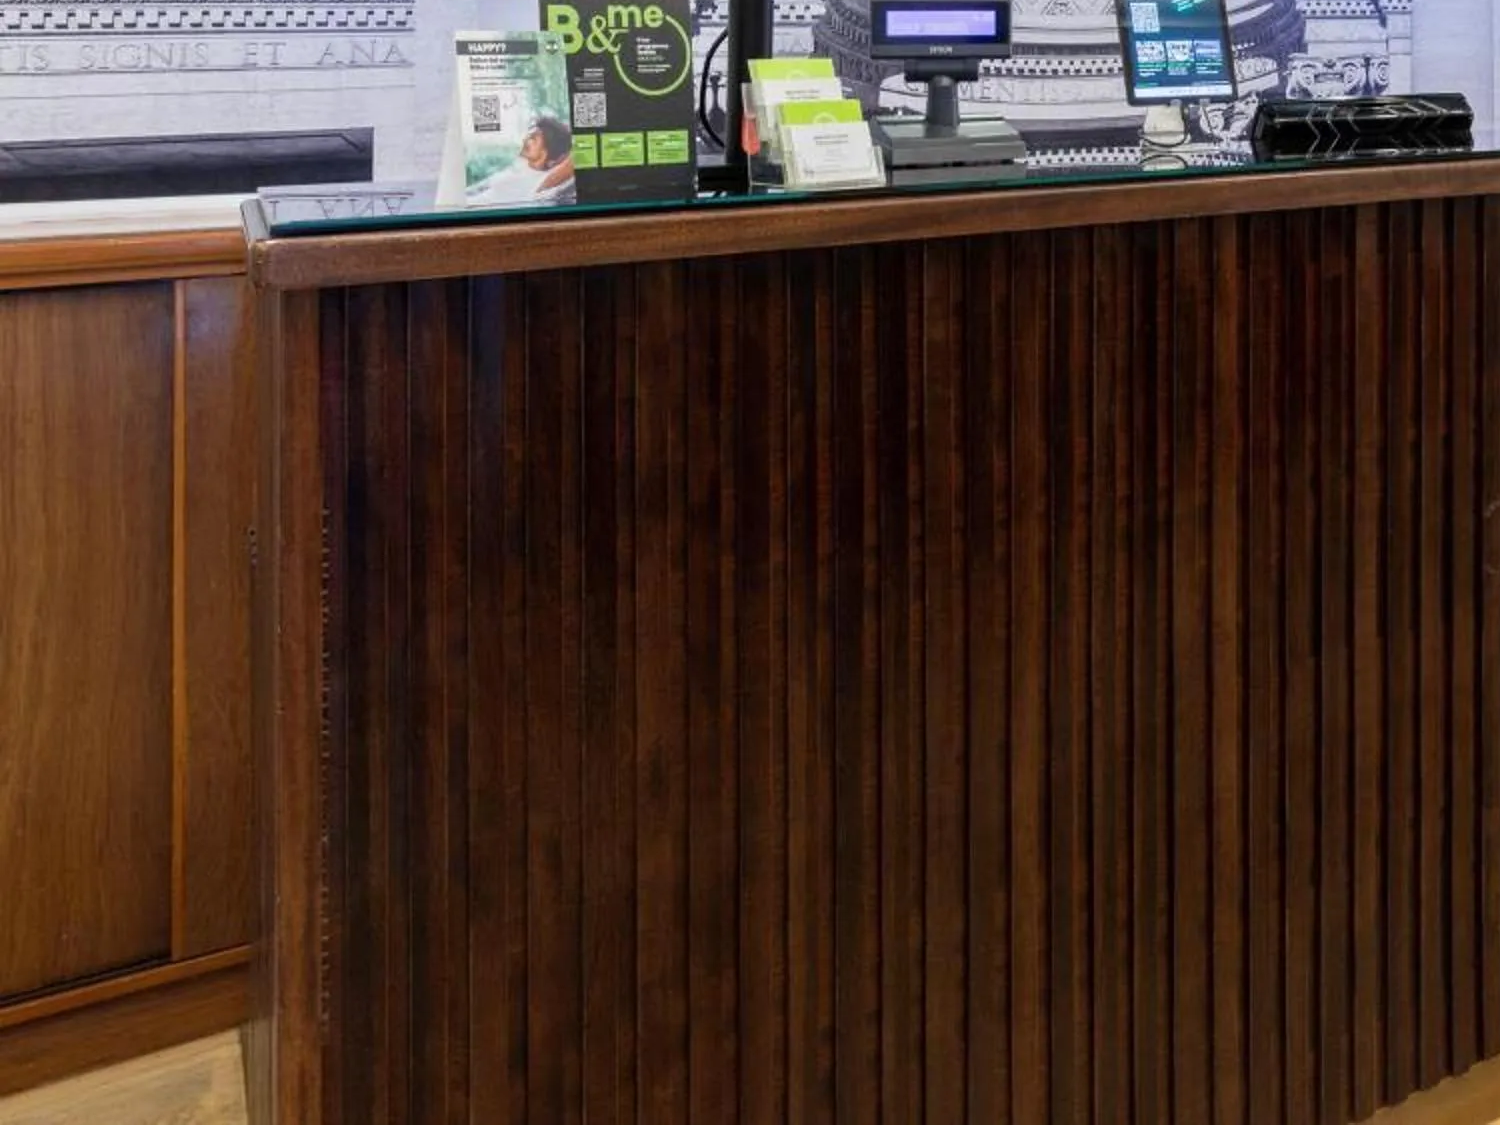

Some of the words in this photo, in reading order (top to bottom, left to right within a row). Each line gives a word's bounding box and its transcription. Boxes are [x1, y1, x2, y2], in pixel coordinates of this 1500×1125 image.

[547, 4, 664, 55] B&me
[242, 41, 287, 67] ET
[467, 41, 507, 54] HAPPY?
